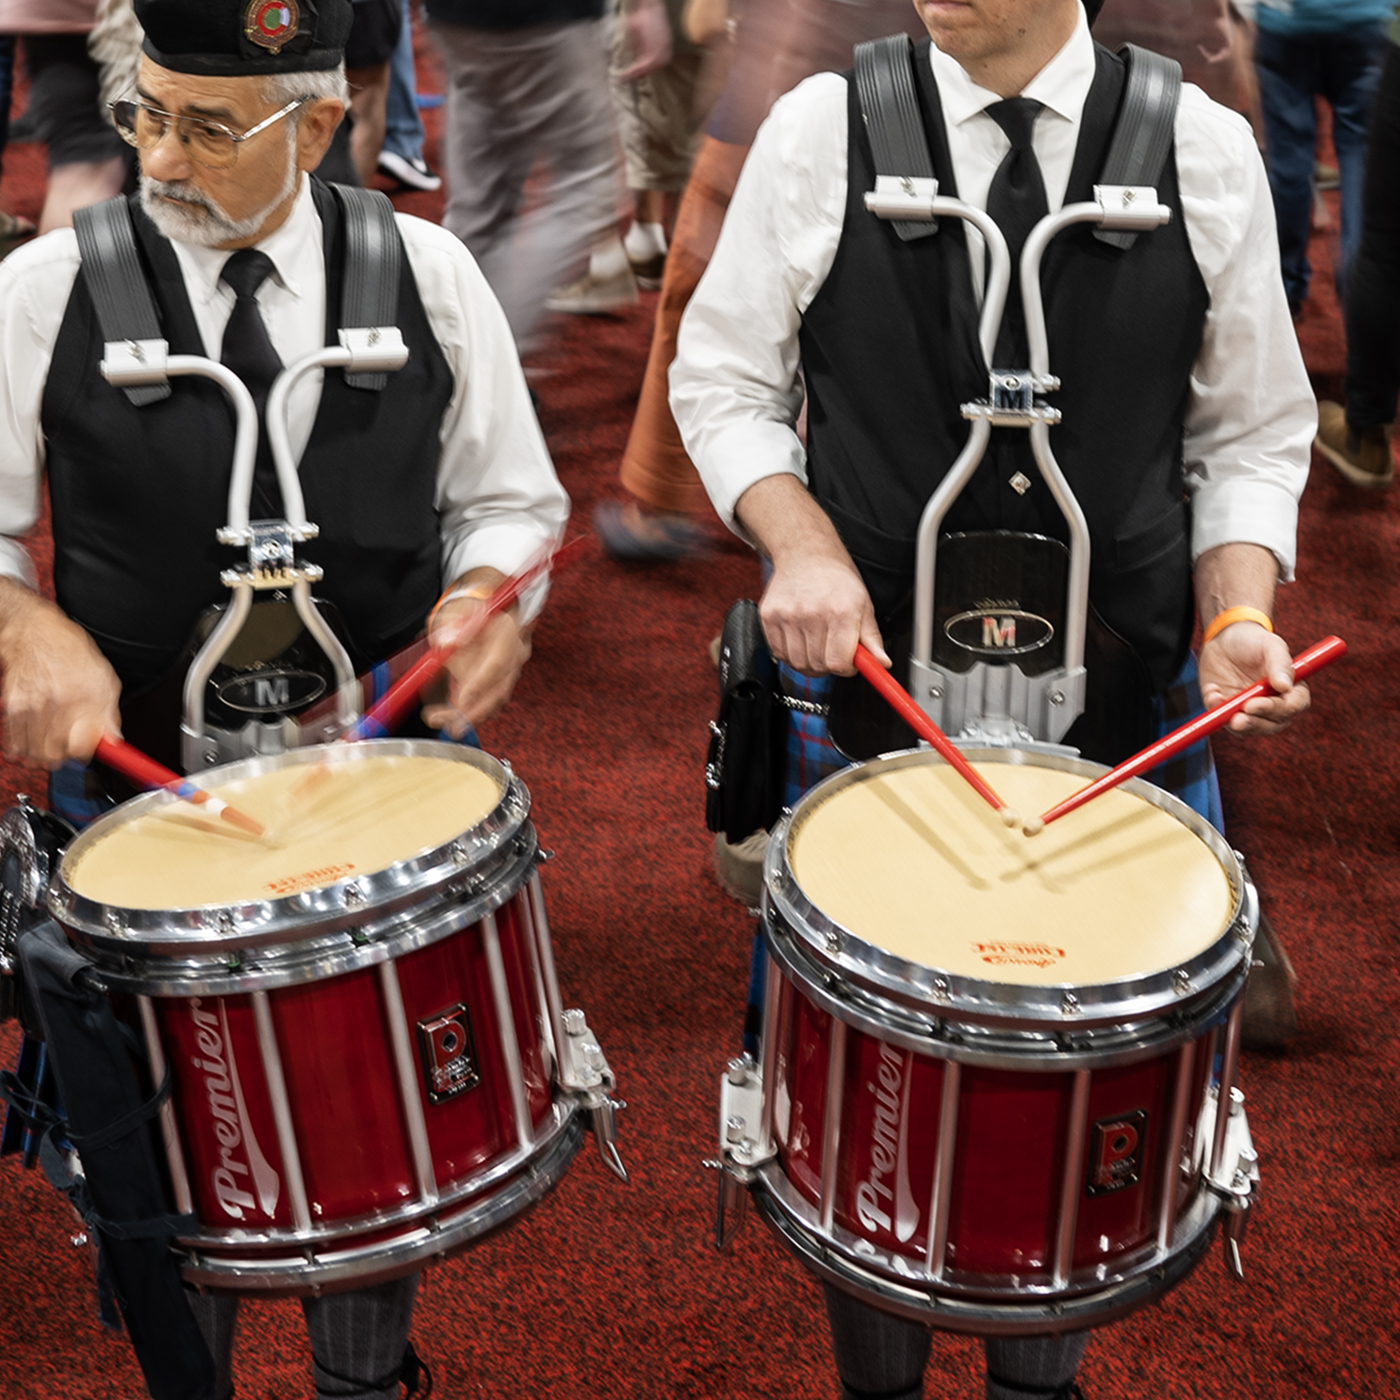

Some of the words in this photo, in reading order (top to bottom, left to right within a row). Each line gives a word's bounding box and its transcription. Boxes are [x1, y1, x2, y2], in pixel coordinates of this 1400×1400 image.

[982, 615, 1016, 648] M
[254, 676, 290, 707] M
[189, 996, 257, 1223] Premier
[856, 1038, 905, 1234] Premier
